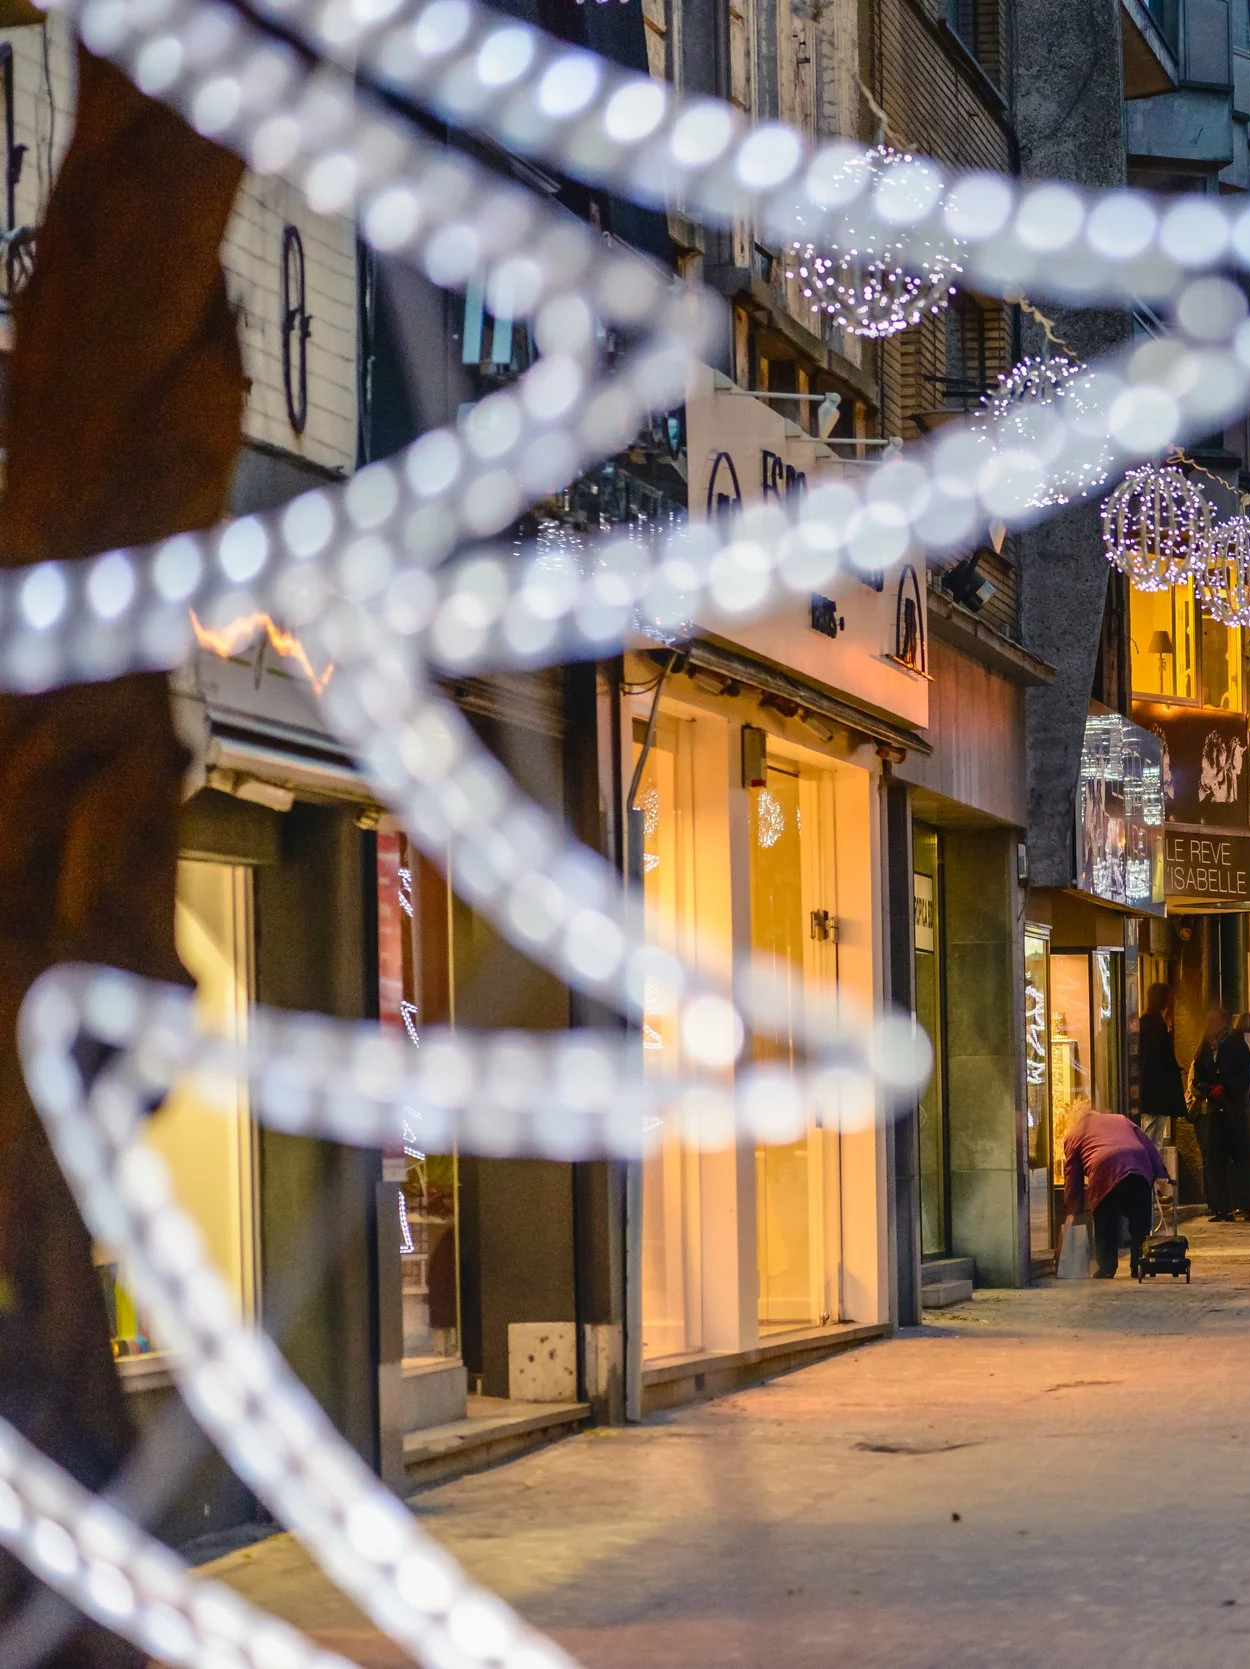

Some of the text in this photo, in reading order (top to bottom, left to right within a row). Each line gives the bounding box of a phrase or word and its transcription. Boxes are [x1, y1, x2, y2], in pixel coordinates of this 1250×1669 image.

[1166, 838, 1232, 866] LE REVE
[1166, 866, 1247, 894] 'ISABELLE
